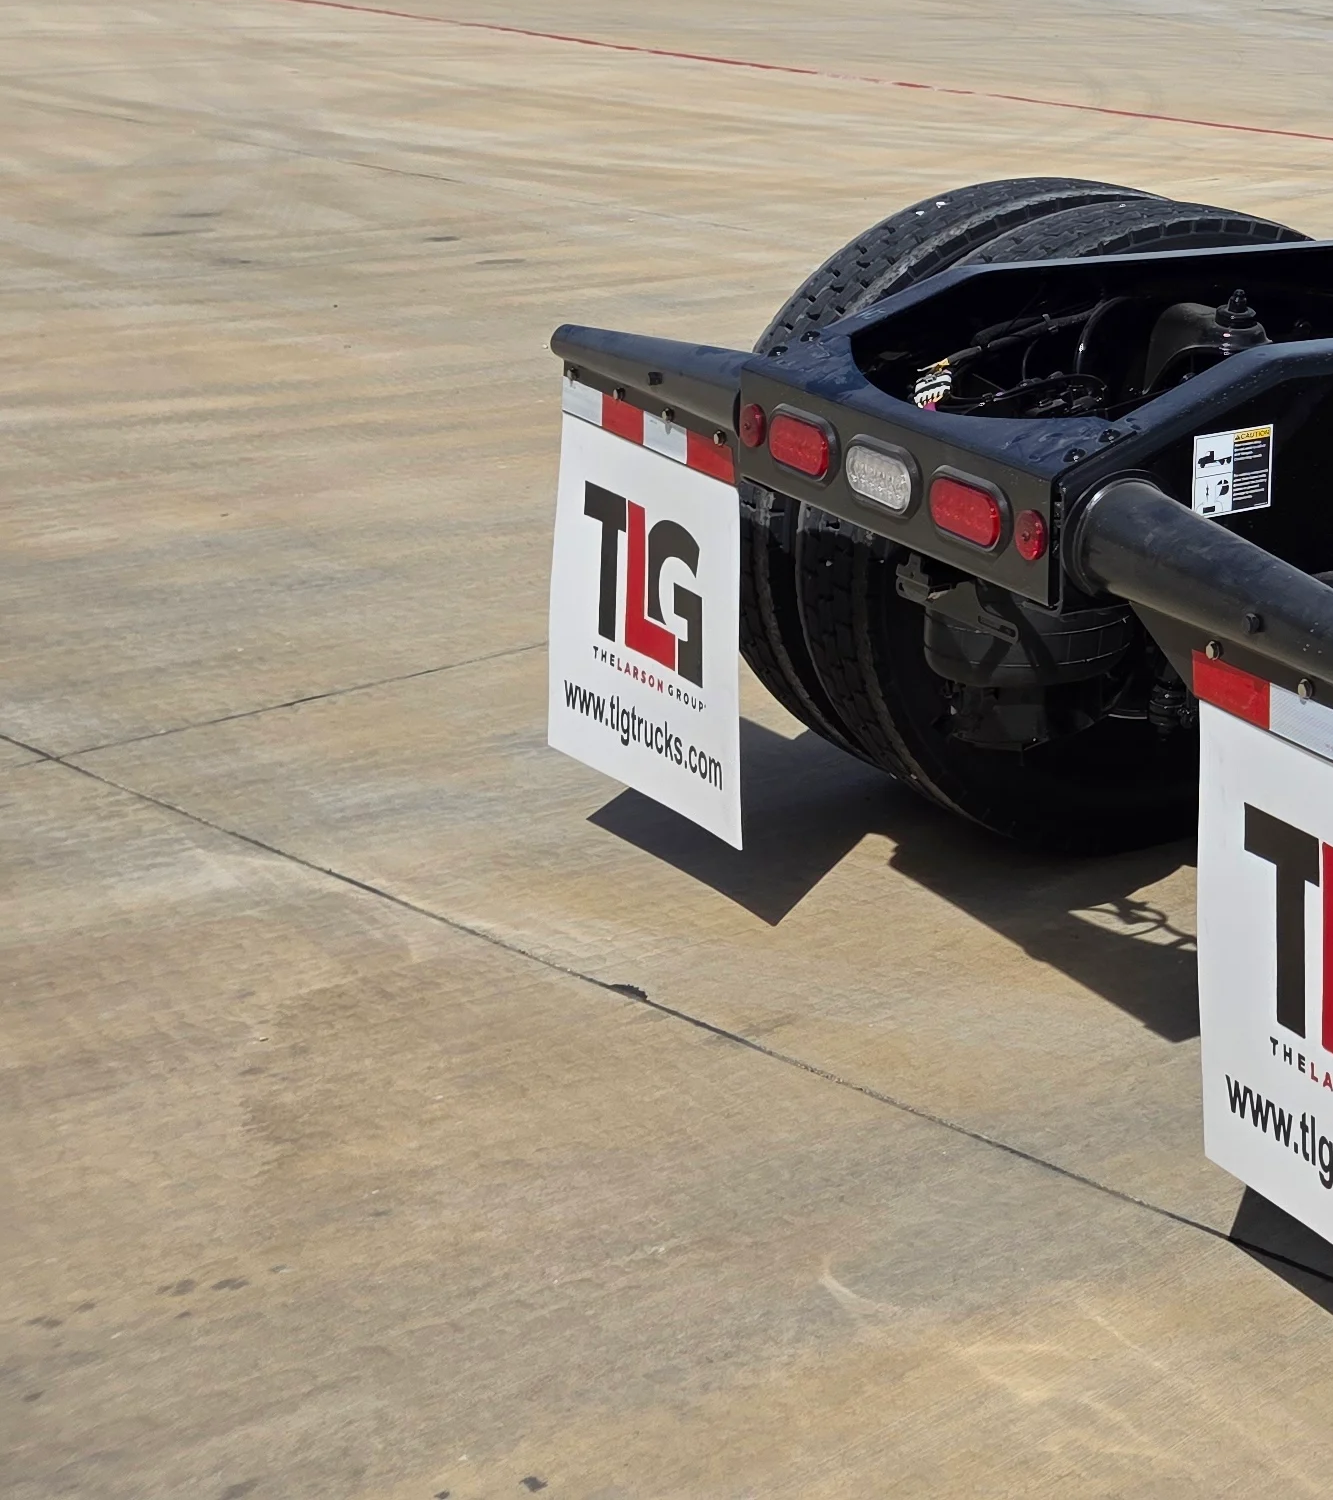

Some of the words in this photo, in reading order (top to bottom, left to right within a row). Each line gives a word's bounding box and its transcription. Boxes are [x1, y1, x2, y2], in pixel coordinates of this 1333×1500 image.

[1240, 429, 1271, 440] CAUTION
[583, 480, 704, 688] TLG
[667, 684, 704, 712] GROUP
[563, 679, 723, 791] www.tlgtrucks.com
